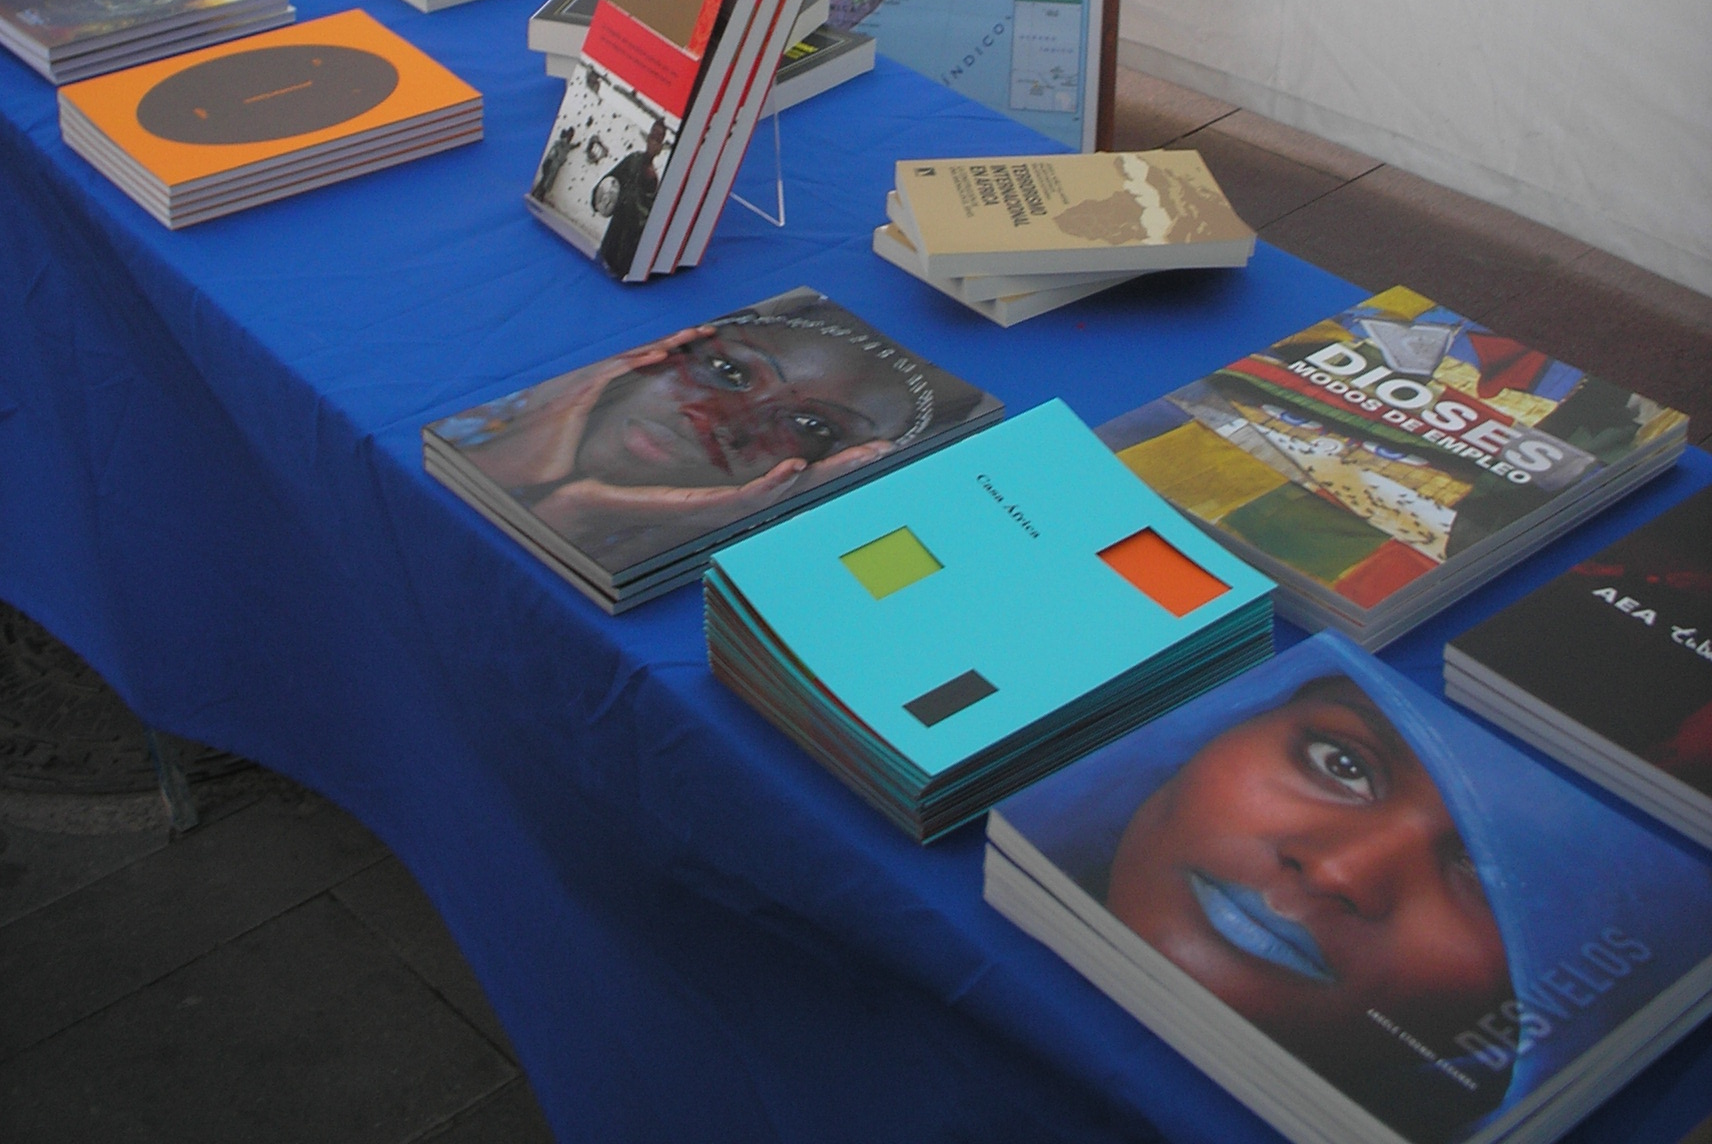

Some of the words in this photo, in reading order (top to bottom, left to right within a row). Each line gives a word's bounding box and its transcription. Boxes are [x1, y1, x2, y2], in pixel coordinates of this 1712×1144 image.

[1288, 360, 1381, 413] MODOS
[1382, 407, 1421, 434] DE
[1422, 428, 1533, 484] EMPLEO
[1304, 342, 1564, 474] DIOSES
[976, 474, 1004, 503] Casa
[1591, 587, 1658, 626] AEA
[1455, 927, 1652, 1072] DESVELOS
